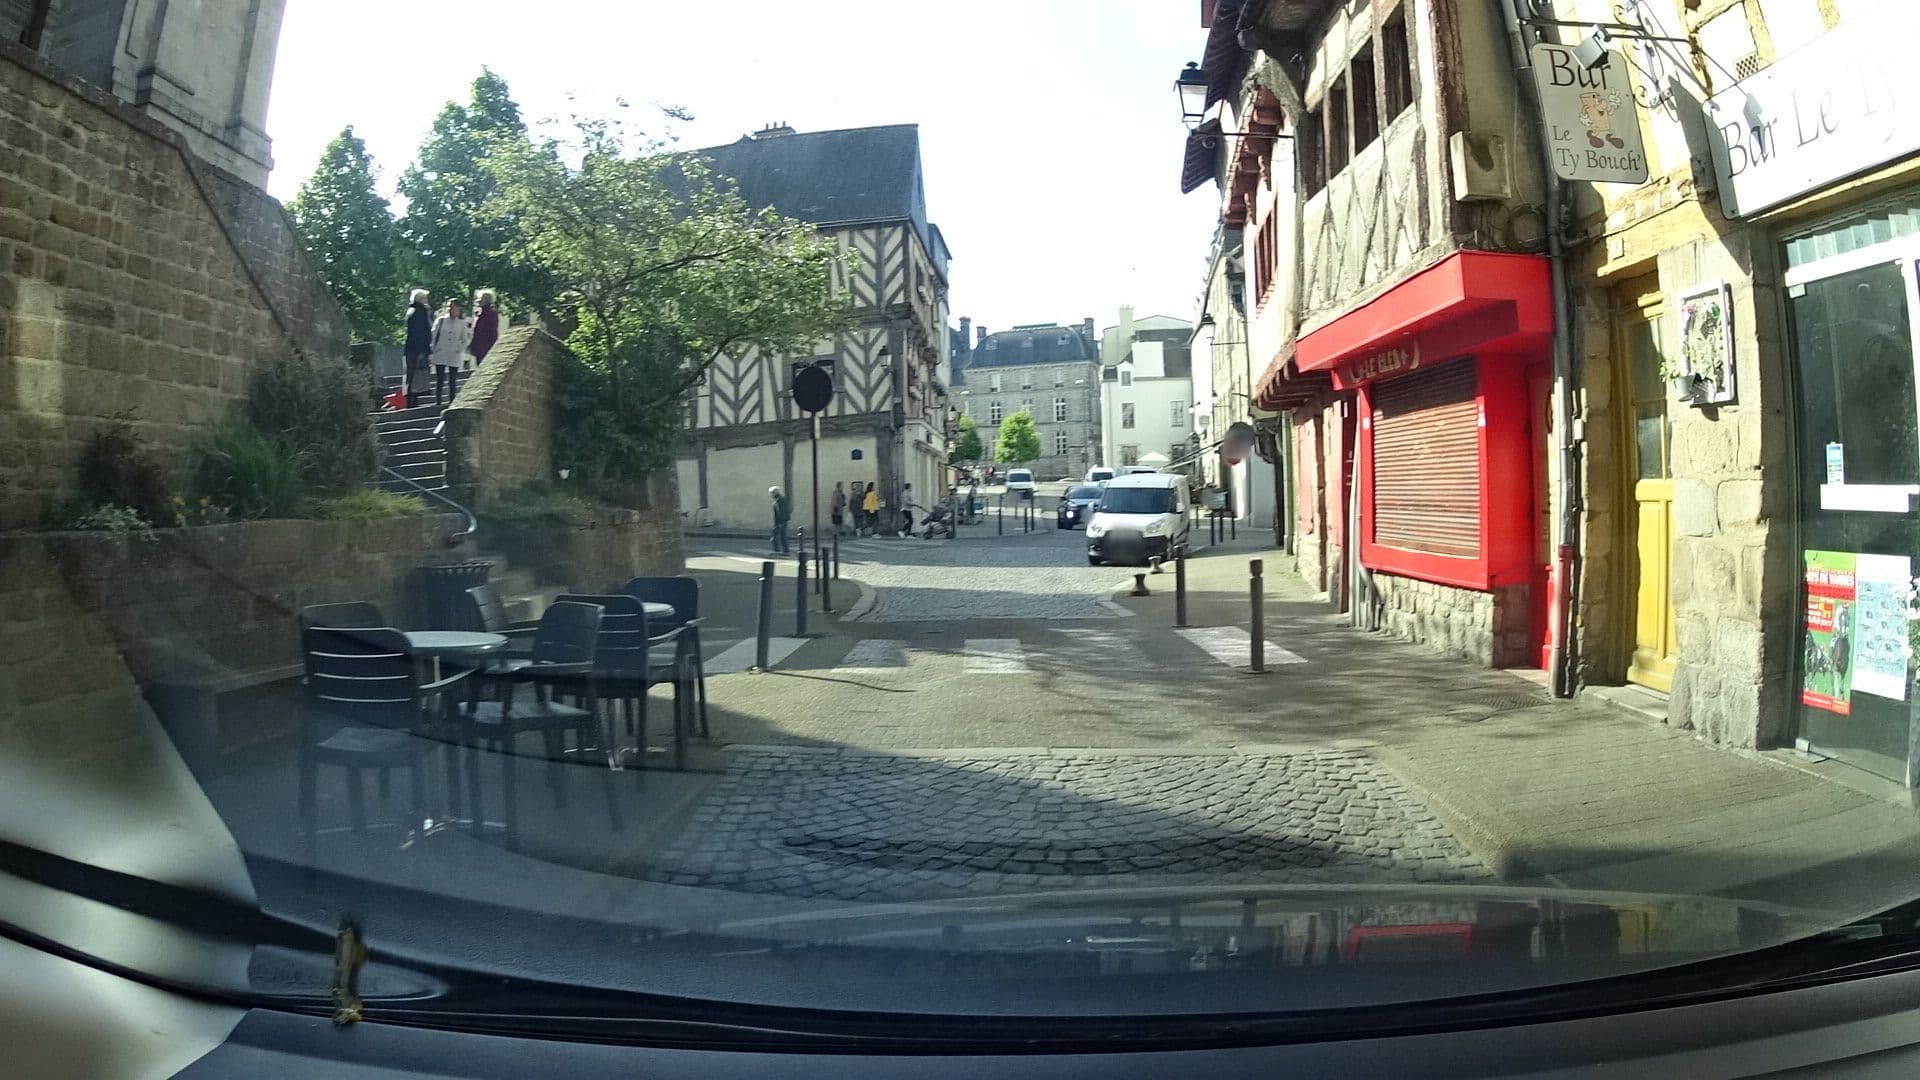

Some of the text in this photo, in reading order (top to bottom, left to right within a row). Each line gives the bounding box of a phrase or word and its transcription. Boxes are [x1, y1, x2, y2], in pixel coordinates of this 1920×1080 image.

[1541, 48, 1611, 90] Bar
[1552, 125, 1572, 141] Le
[1720, 113, 1777, 178] Bar
[1785, 89, 1840, 148] Le
[1556, 148, 1641, 175] Ty Bouch'
